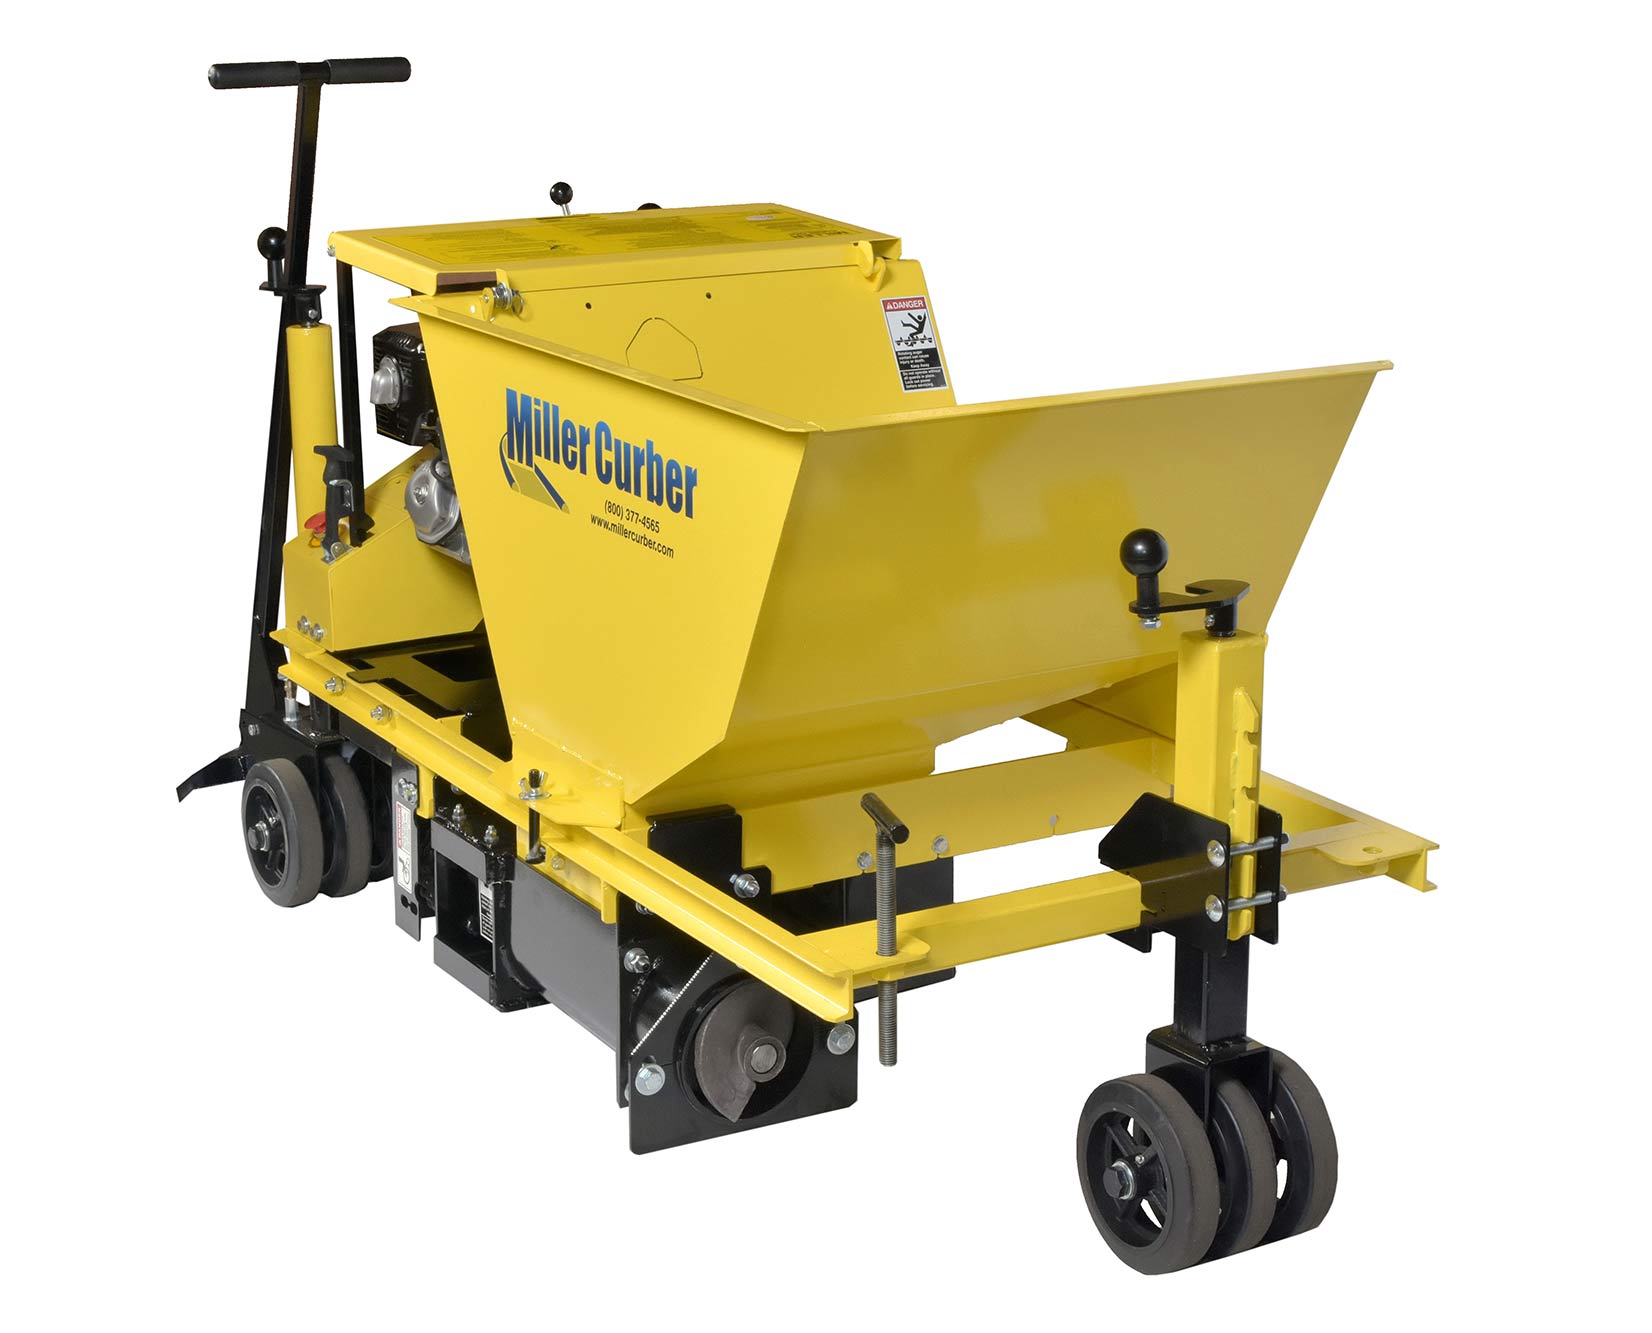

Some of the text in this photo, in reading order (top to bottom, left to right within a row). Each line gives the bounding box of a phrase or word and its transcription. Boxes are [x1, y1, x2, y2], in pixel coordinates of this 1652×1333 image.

[892, 300, 924, 310] DANGER
[506, 388, 698, 520] Miller Curber
[590, 514, 675, 559] www.millercurber.com
[604, 500, 660, 534] (800) 377-4565
